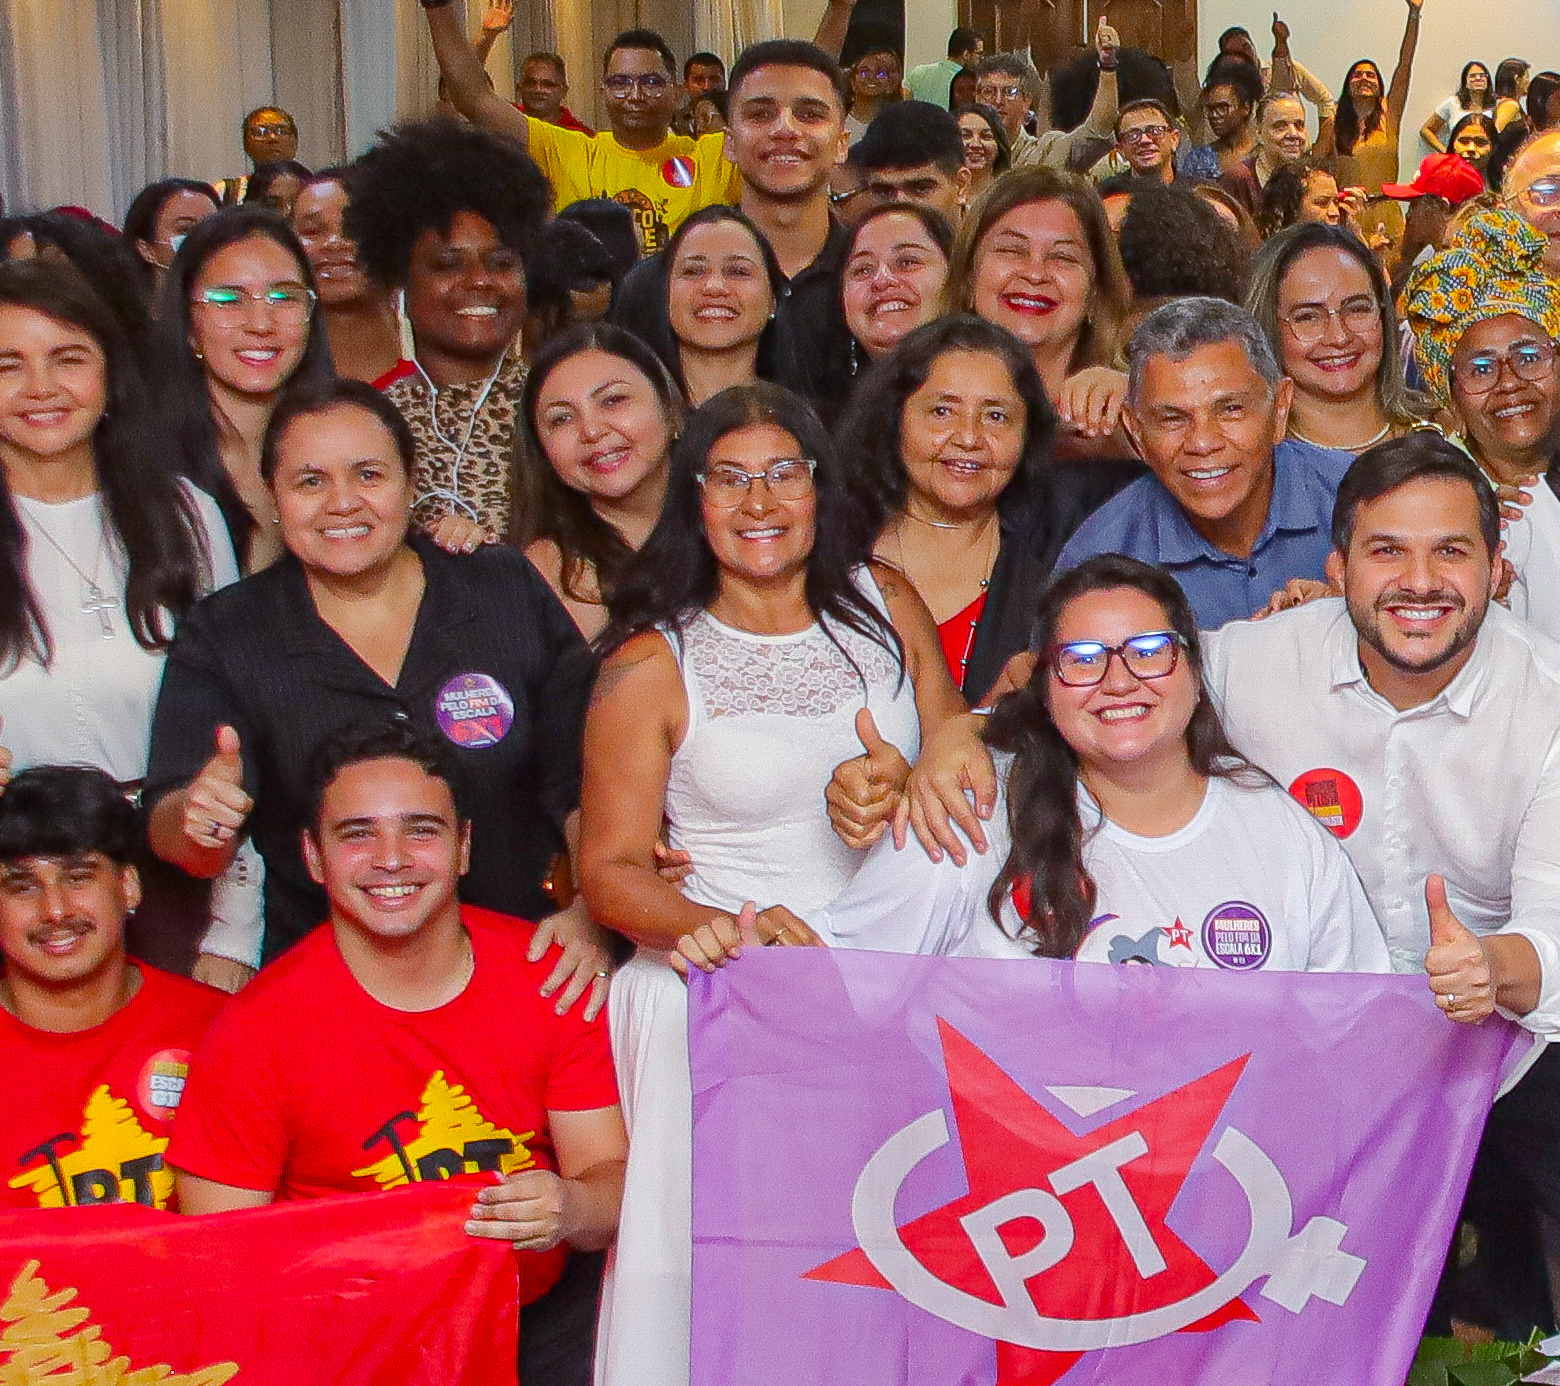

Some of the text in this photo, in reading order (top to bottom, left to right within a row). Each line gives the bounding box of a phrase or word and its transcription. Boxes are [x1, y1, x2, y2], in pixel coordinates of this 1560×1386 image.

[452, 706, 498, 720] ESCALA
[1171, 928, 1189, 943] PT
[959, 1130, 1170, 1315] PT
